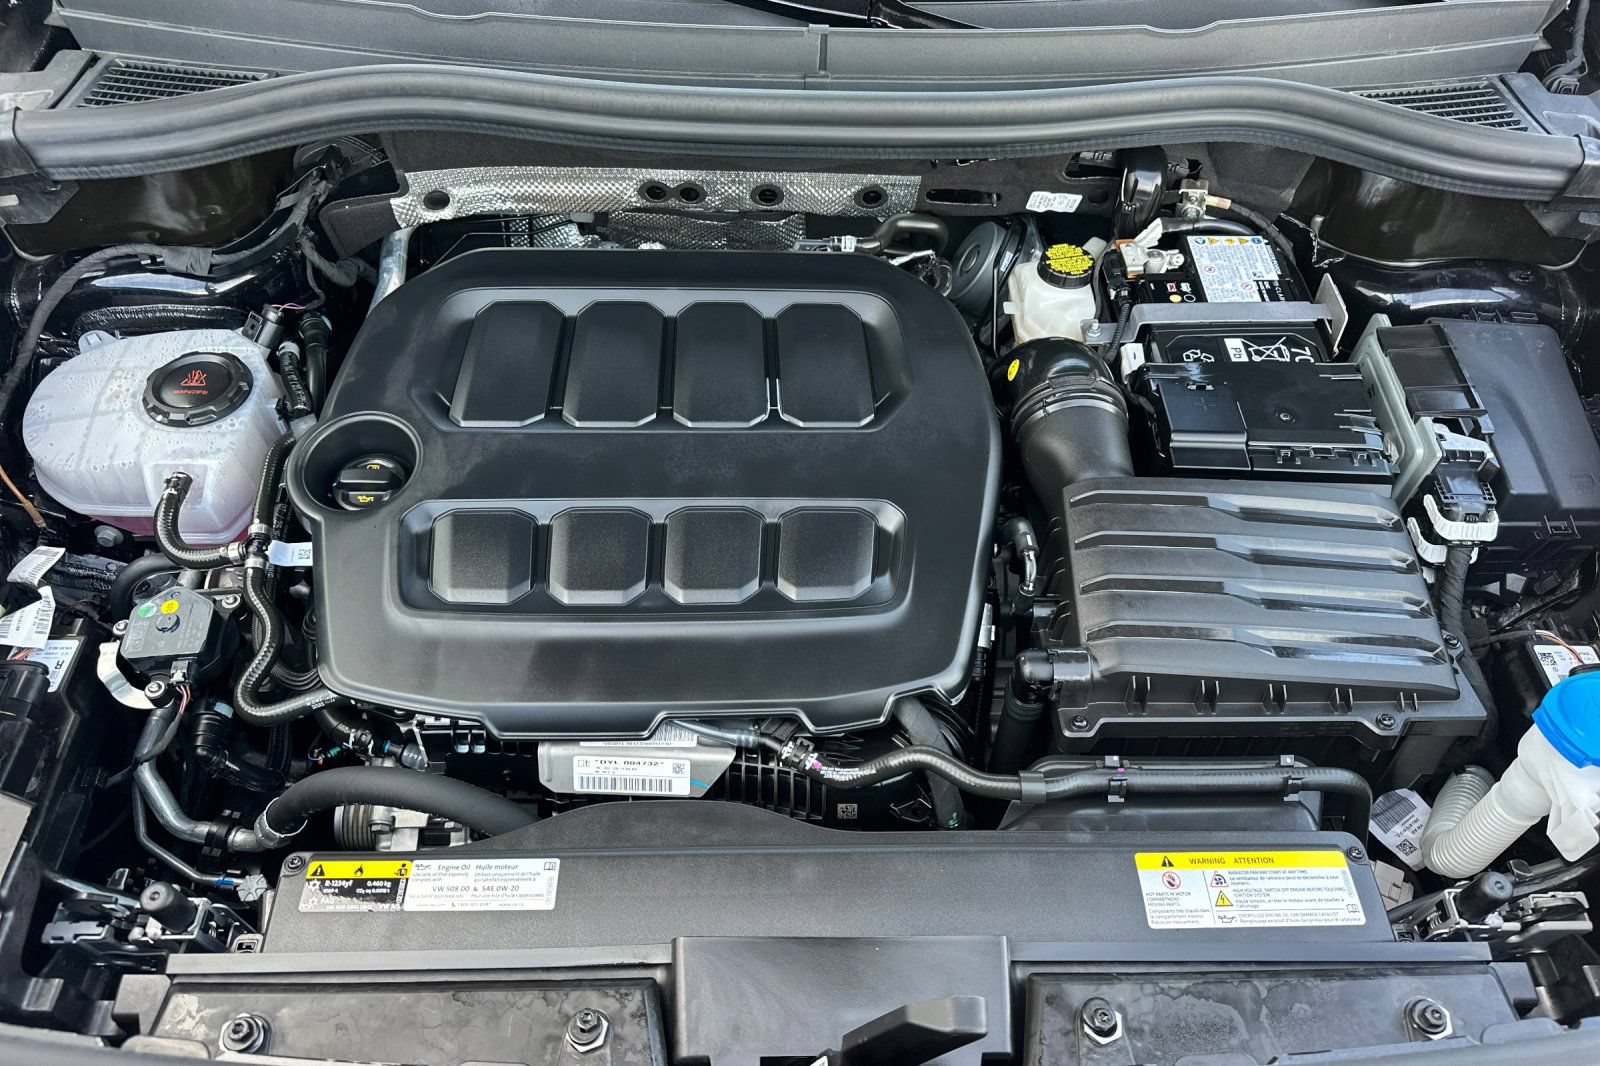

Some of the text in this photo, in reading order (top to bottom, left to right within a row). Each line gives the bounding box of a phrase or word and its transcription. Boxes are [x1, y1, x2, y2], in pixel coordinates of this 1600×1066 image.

[1230, 348, 1242, 358] Pb
[1188, 856, 1274, 865] WARNING ATTENTION
[324, 880, 353, 888] R-1234yf
